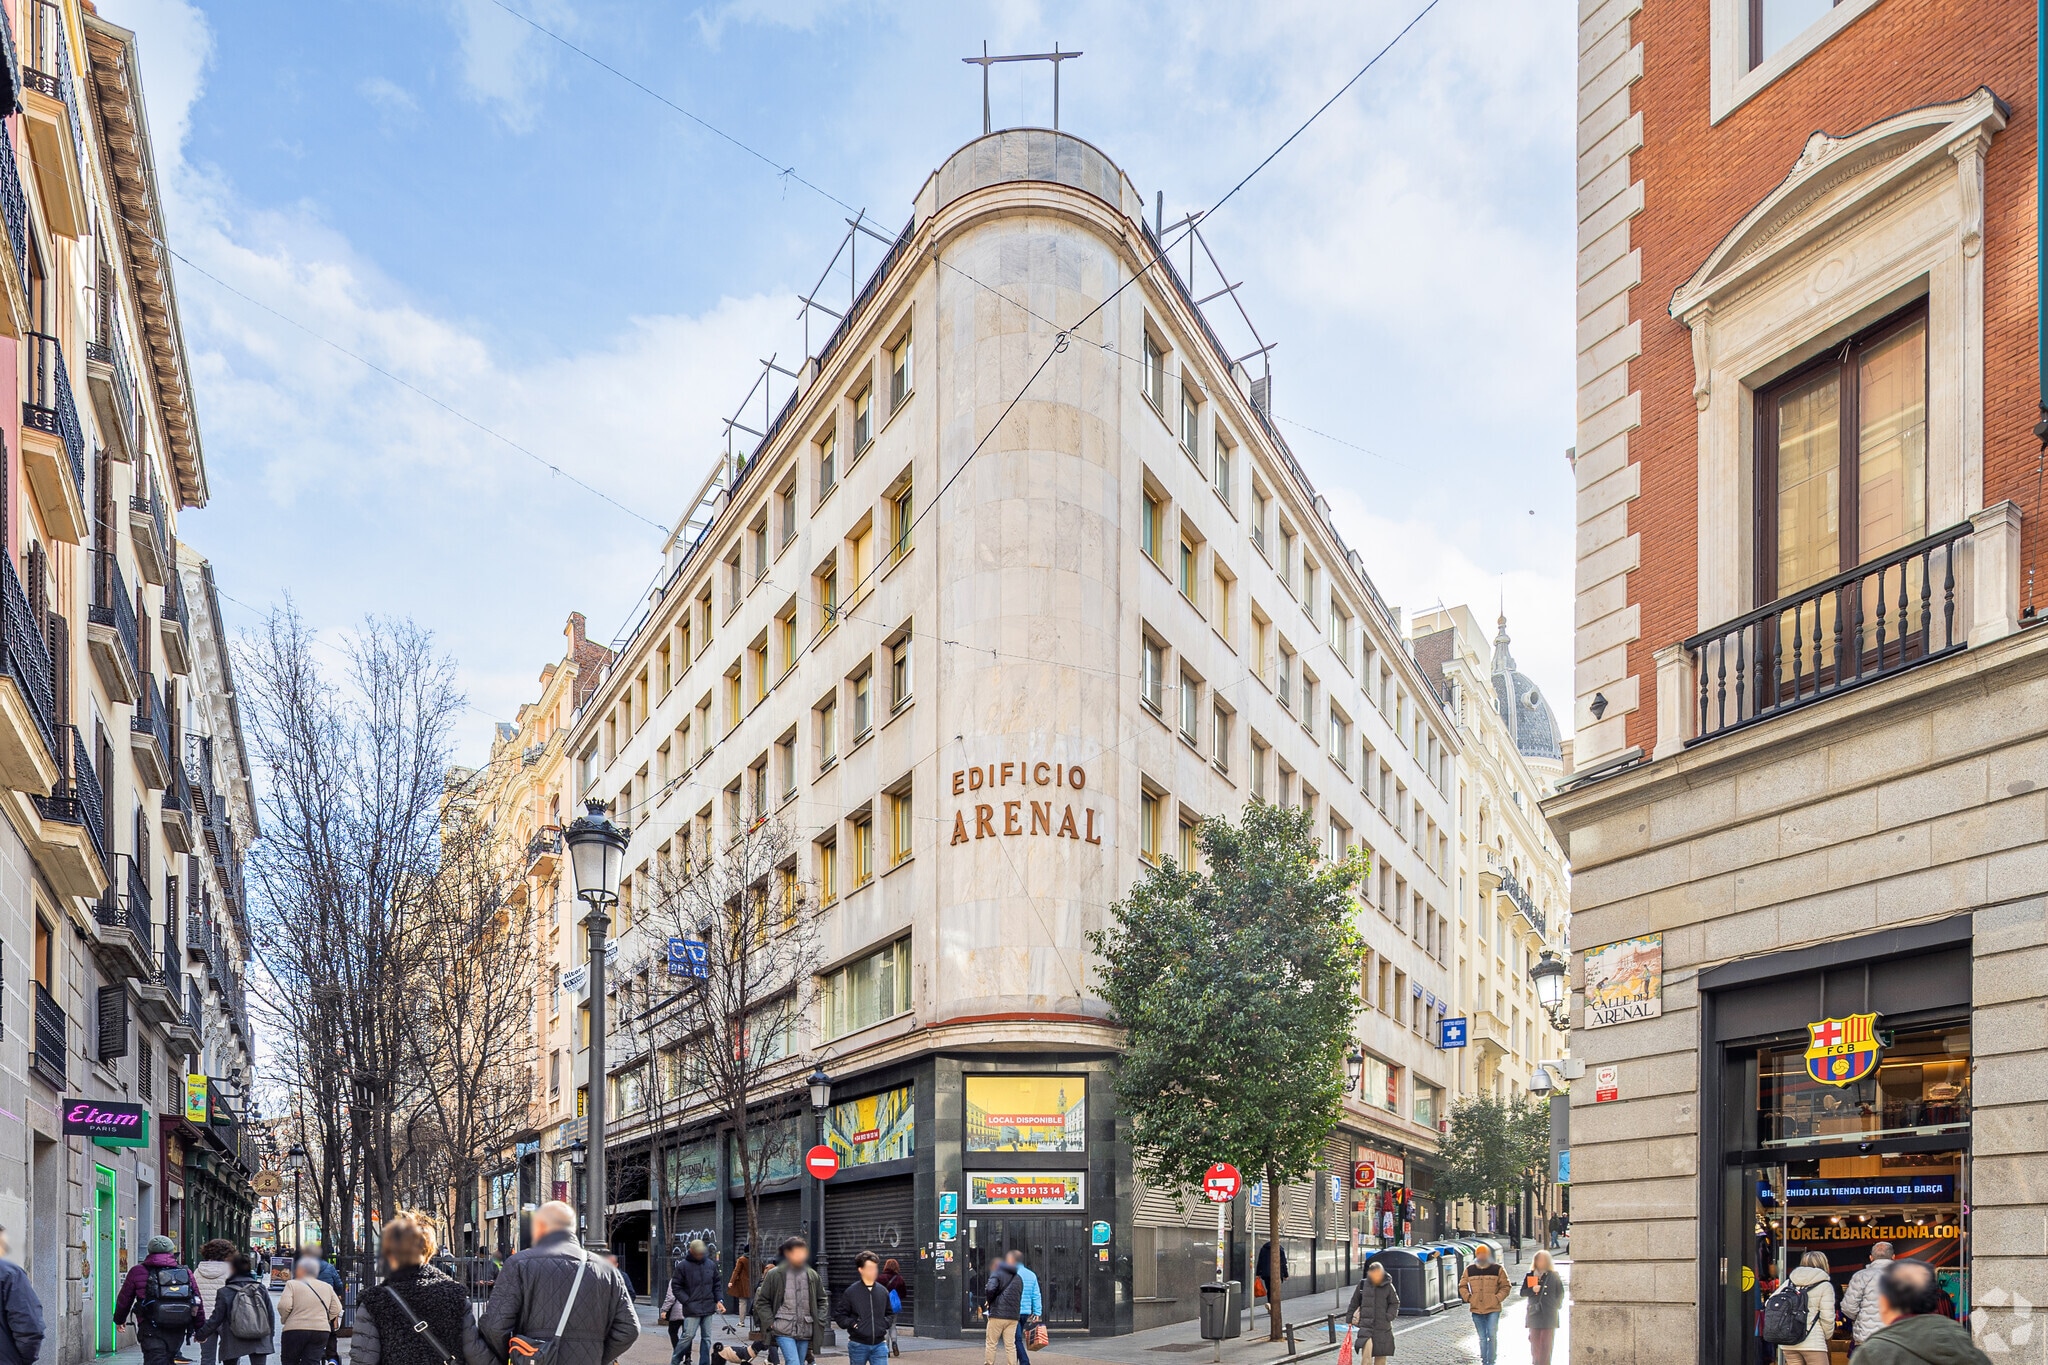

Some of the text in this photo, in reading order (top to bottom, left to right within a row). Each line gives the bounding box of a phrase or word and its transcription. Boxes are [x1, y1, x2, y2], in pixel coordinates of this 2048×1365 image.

[952, 761, 1086, 795] EDIFICIO
[950, 800, 1101, 846] ARENAL
[1592, 995, 1632, 1011] CALLE
[1591, 1003, 1654, 1026] ARENAL
[67, 1104, 139, 1126] Etam
[988, 1116, 1062, 1124] LOCAL DISPONIBLE
[264, 1178, 271, 1187] 8
[1761, 1185, 1943, 1197] BIENIDO A LA TIENDA OFICIAL DEL BARÇA
